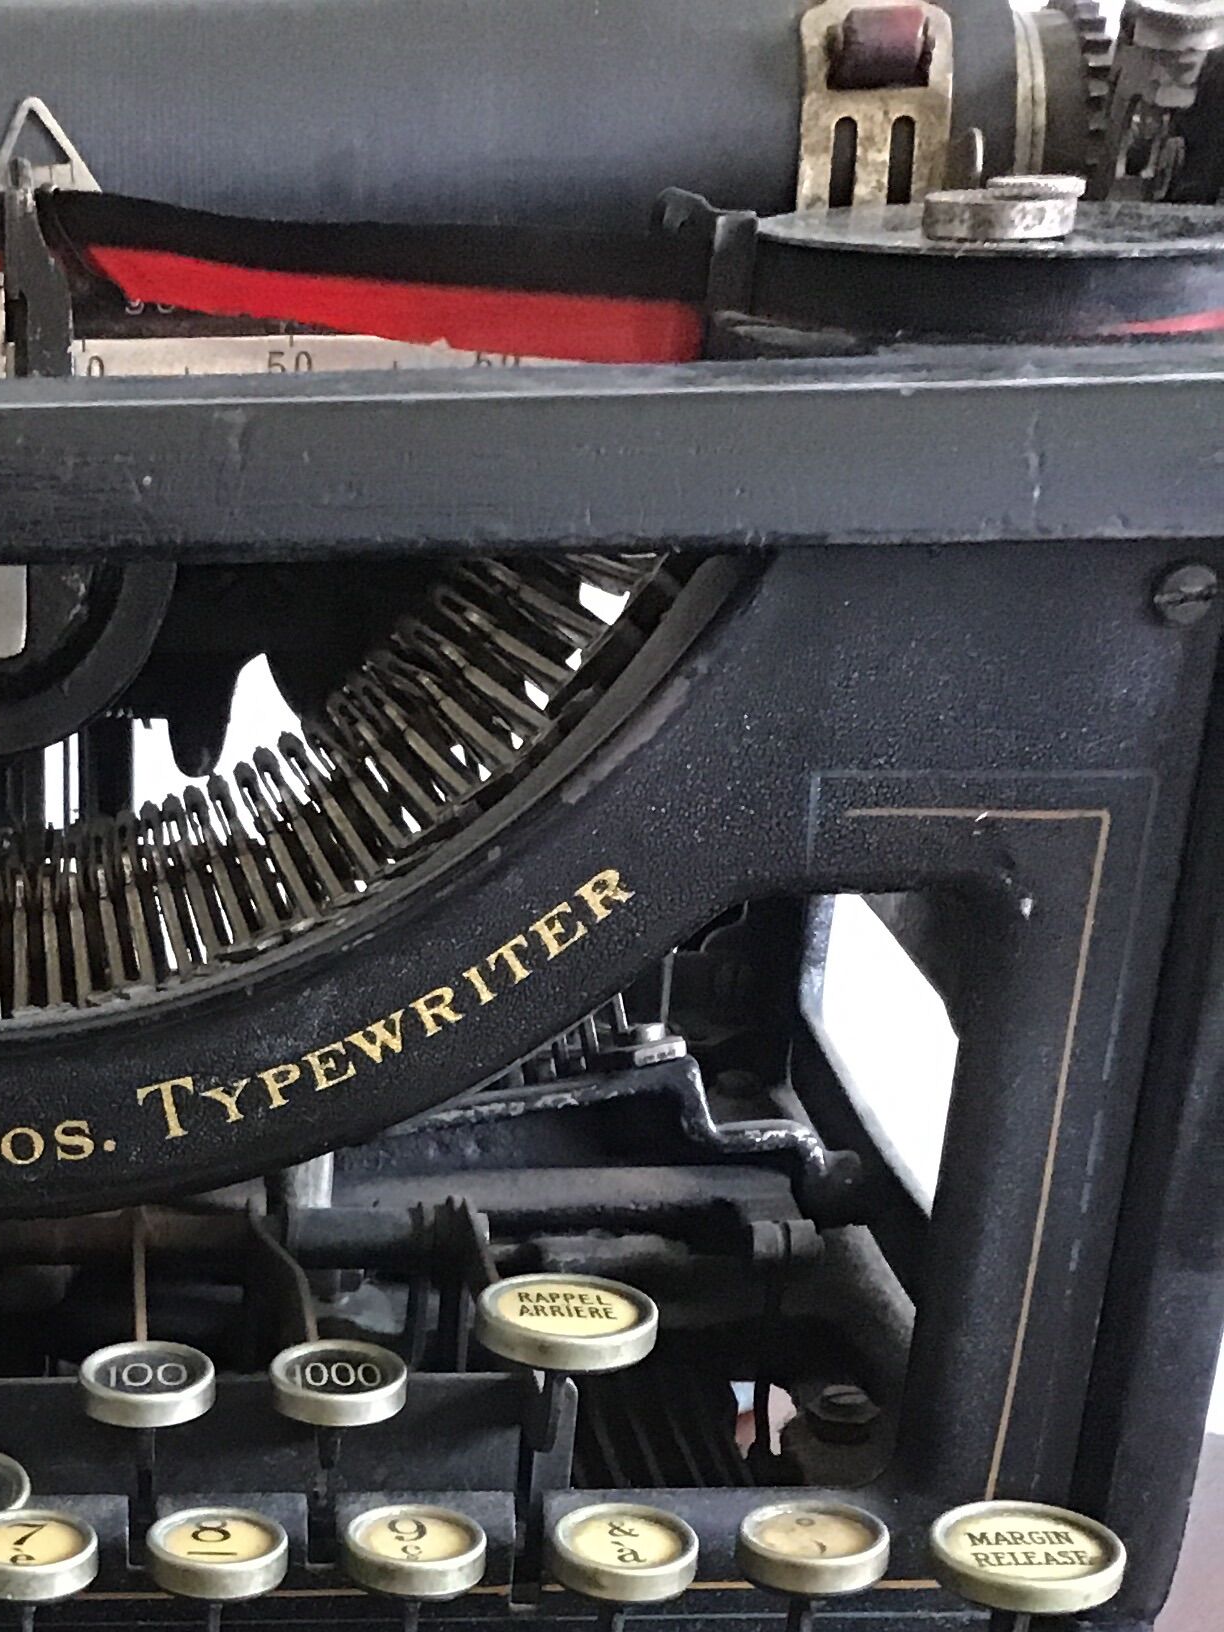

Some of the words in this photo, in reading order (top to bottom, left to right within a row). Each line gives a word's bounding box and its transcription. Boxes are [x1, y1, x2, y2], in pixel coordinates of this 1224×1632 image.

[517, 1292, 612, 1307] RAPPEL
[108, 1362, 188, 1388] 100
[292, 1362, 381, 1388] 1000
[7, 1523, 46, 1547] 7
[191, 1514, 231, 1543] 8
[387, 1517, 427, 1542] 9
[608, 1521, 639, 1539] &
[966, 1531, 1074, 1546] MARGIN
[975, 1551, 1094, 1567] RELEASE
